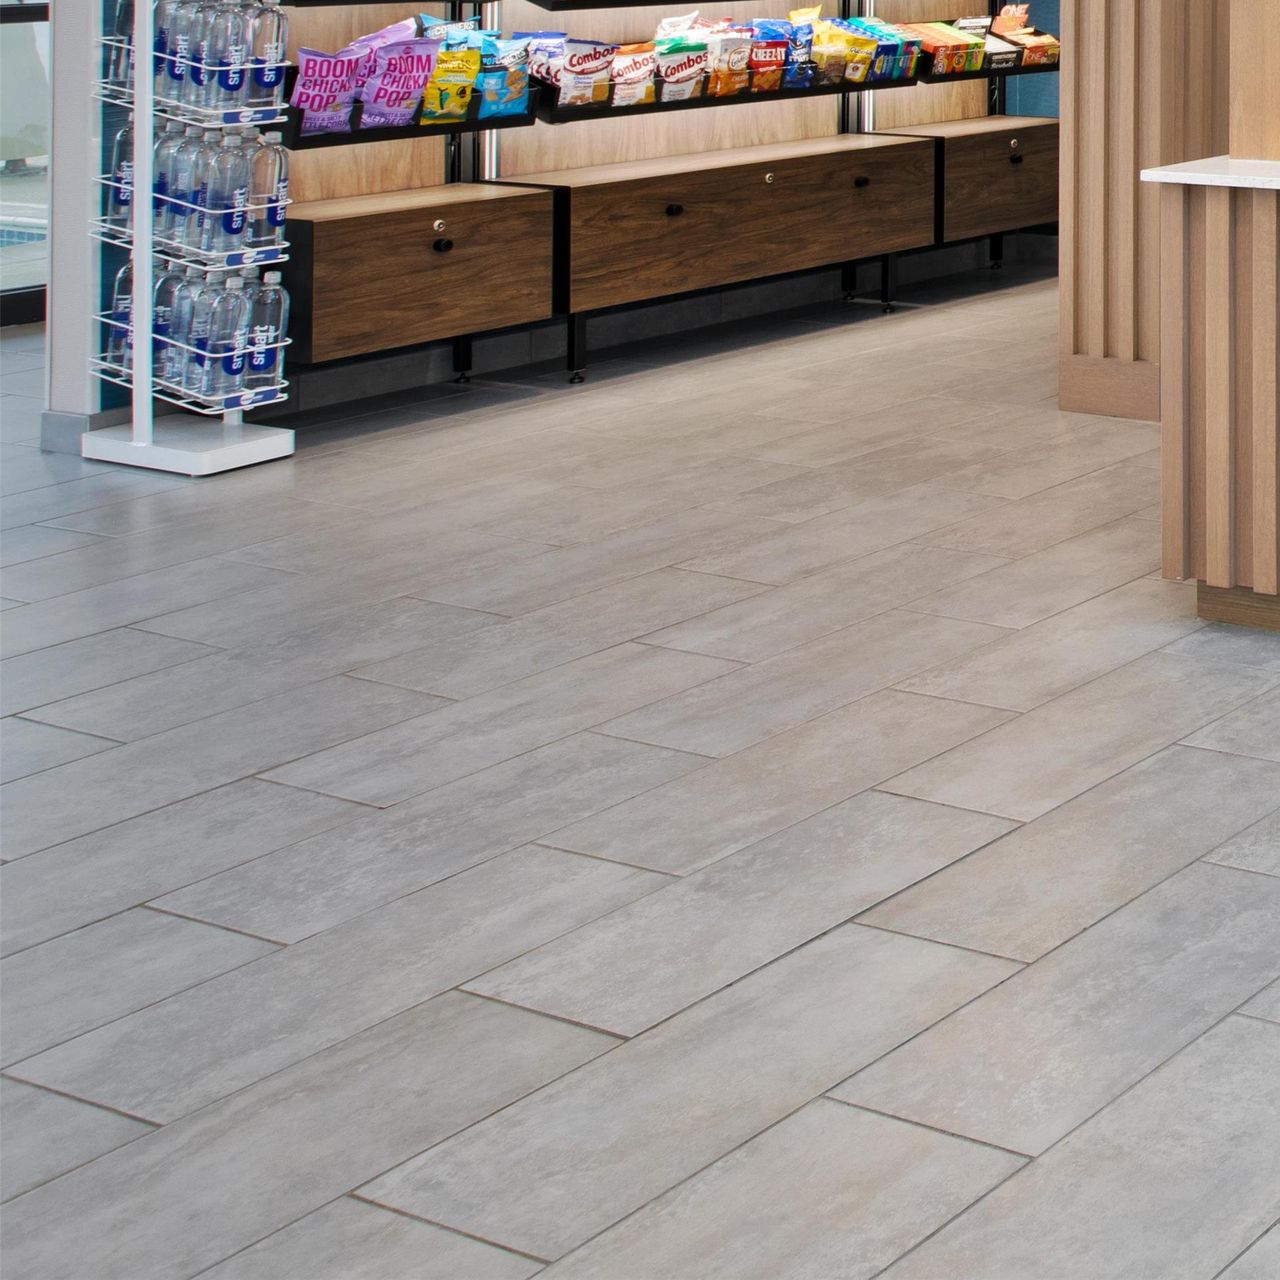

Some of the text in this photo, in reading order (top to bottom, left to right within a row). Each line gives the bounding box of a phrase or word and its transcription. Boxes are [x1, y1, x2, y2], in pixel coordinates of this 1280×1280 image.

[1001, 4, 1030, 17] ONE
[304, 57, 360, 79] BOOM
[387, 54, 432, 75] BOOM
[611, 54, 657, 80] Combos
[664, 51, 709, 78] Combos
[295, 91, 338, 113] POP
[372, 86, 413, 108] POP
